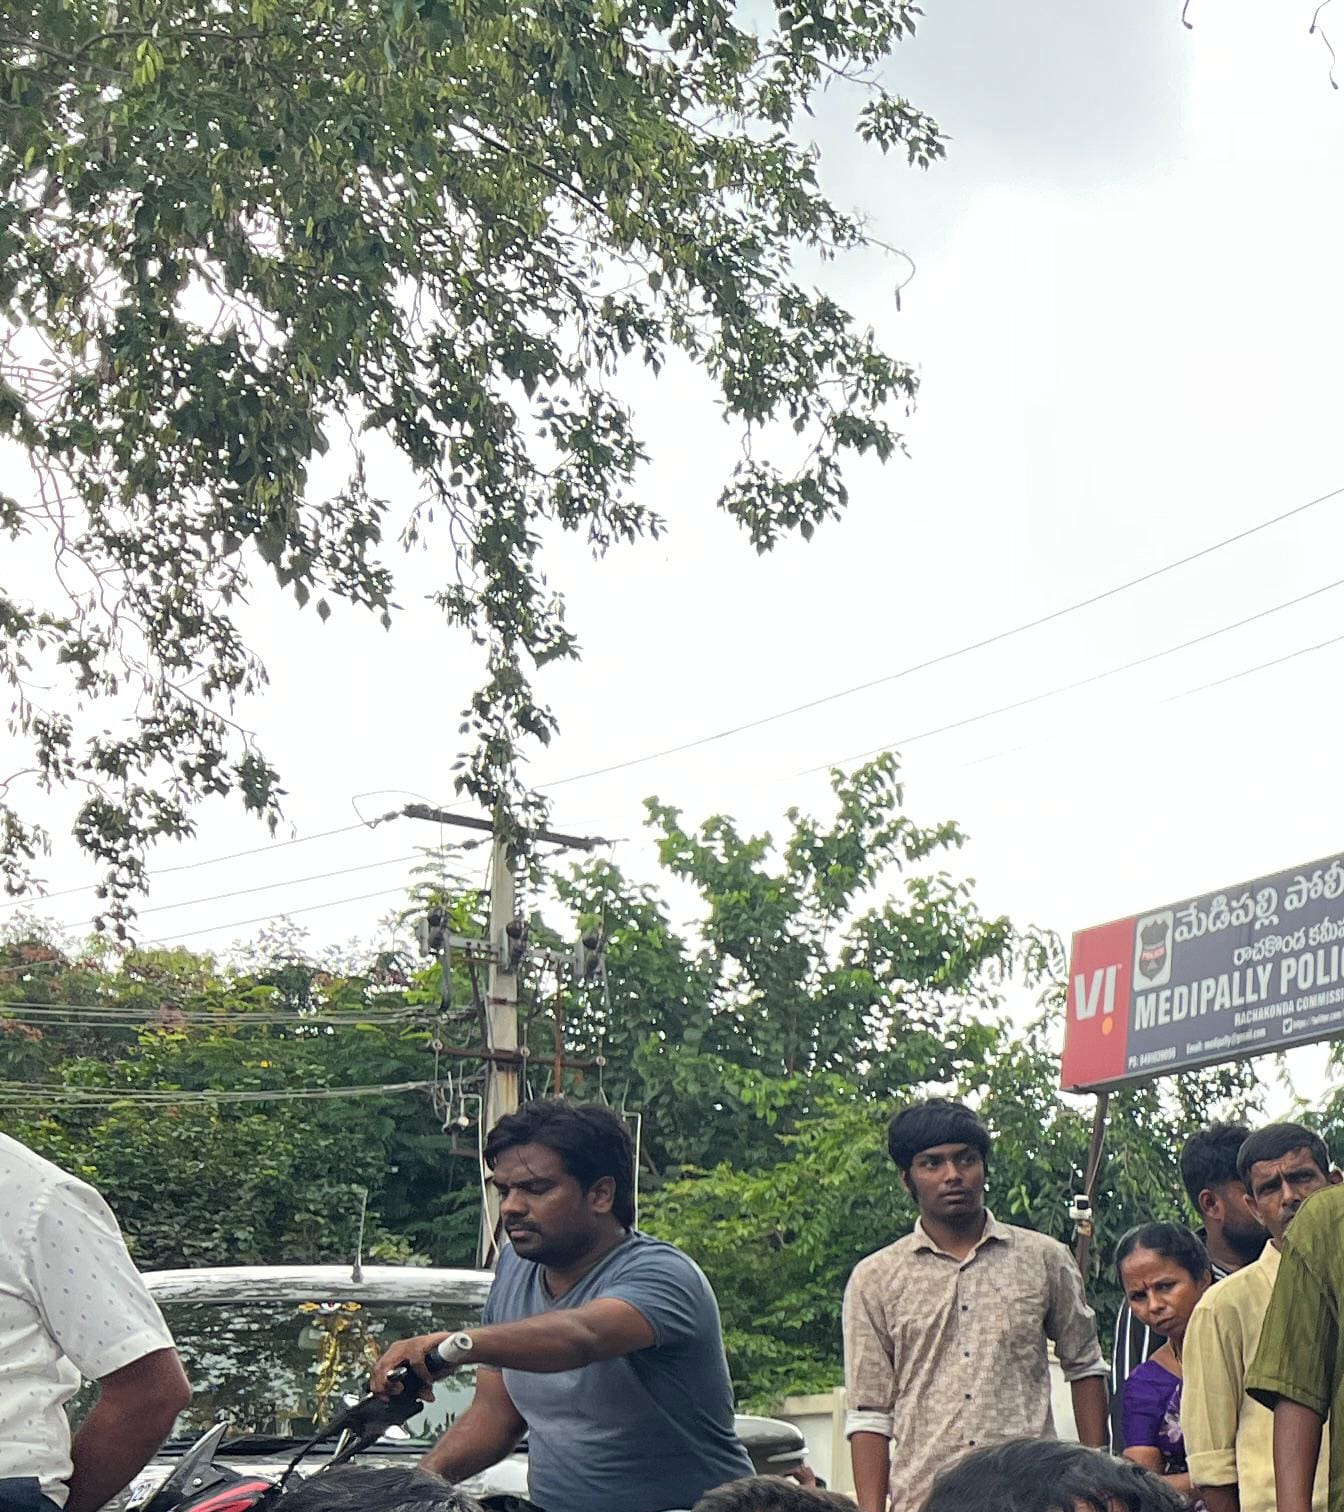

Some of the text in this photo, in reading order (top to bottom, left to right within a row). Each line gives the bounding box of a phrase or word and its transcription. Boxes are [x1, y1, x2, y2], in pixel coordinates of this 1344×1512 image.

[1174, 886, 1279, 942] మేడిపల్లి
[1233, 927, 1305, 966] రాచకొండ
[1134, 962, 1273, 1031] MEDIPALLY
[1234, 1000, 1295, 1028] RACHAKONDA
